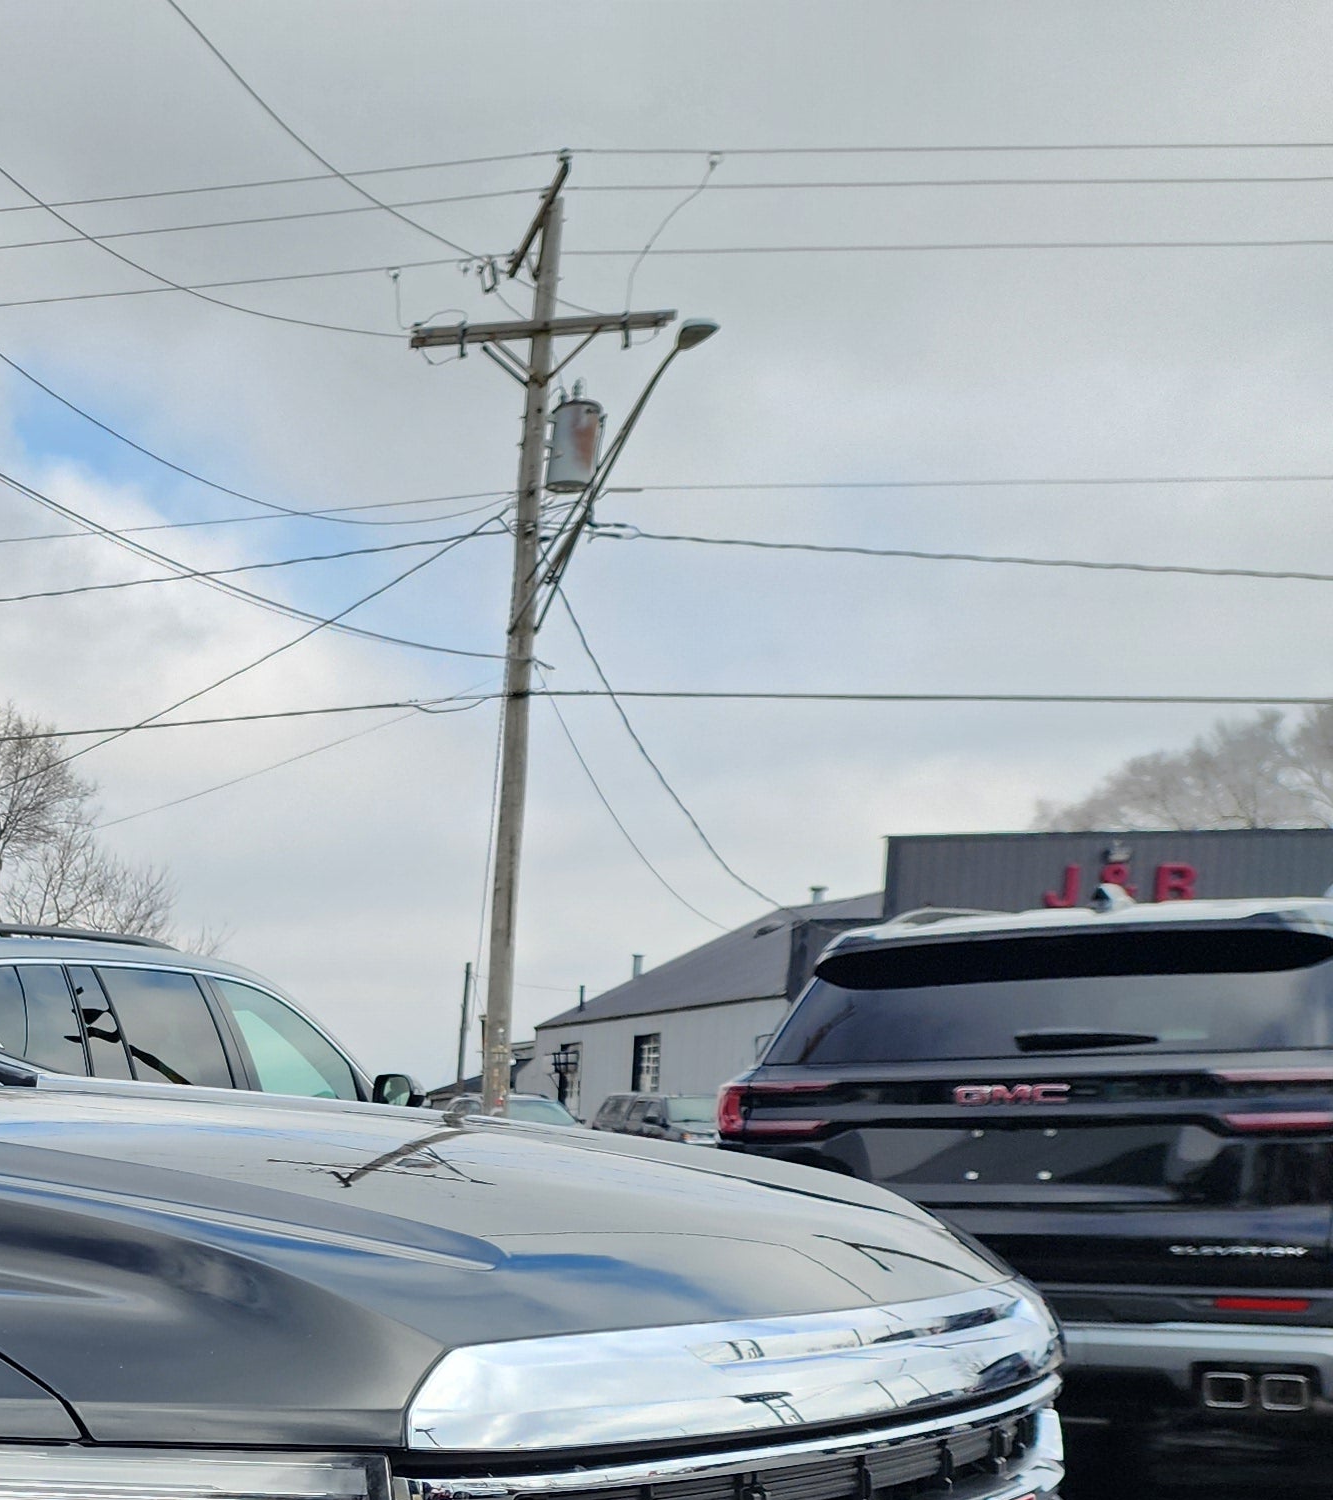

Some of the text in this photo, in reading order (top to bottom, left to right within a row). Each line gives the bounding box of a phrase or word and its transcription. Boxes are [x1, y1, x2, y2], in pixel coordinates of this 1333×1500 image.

[1043, 863, 1080, 908] J
[1155, 862, 1198, 902] B
[953, 1083, 1071, 1106] GMC
